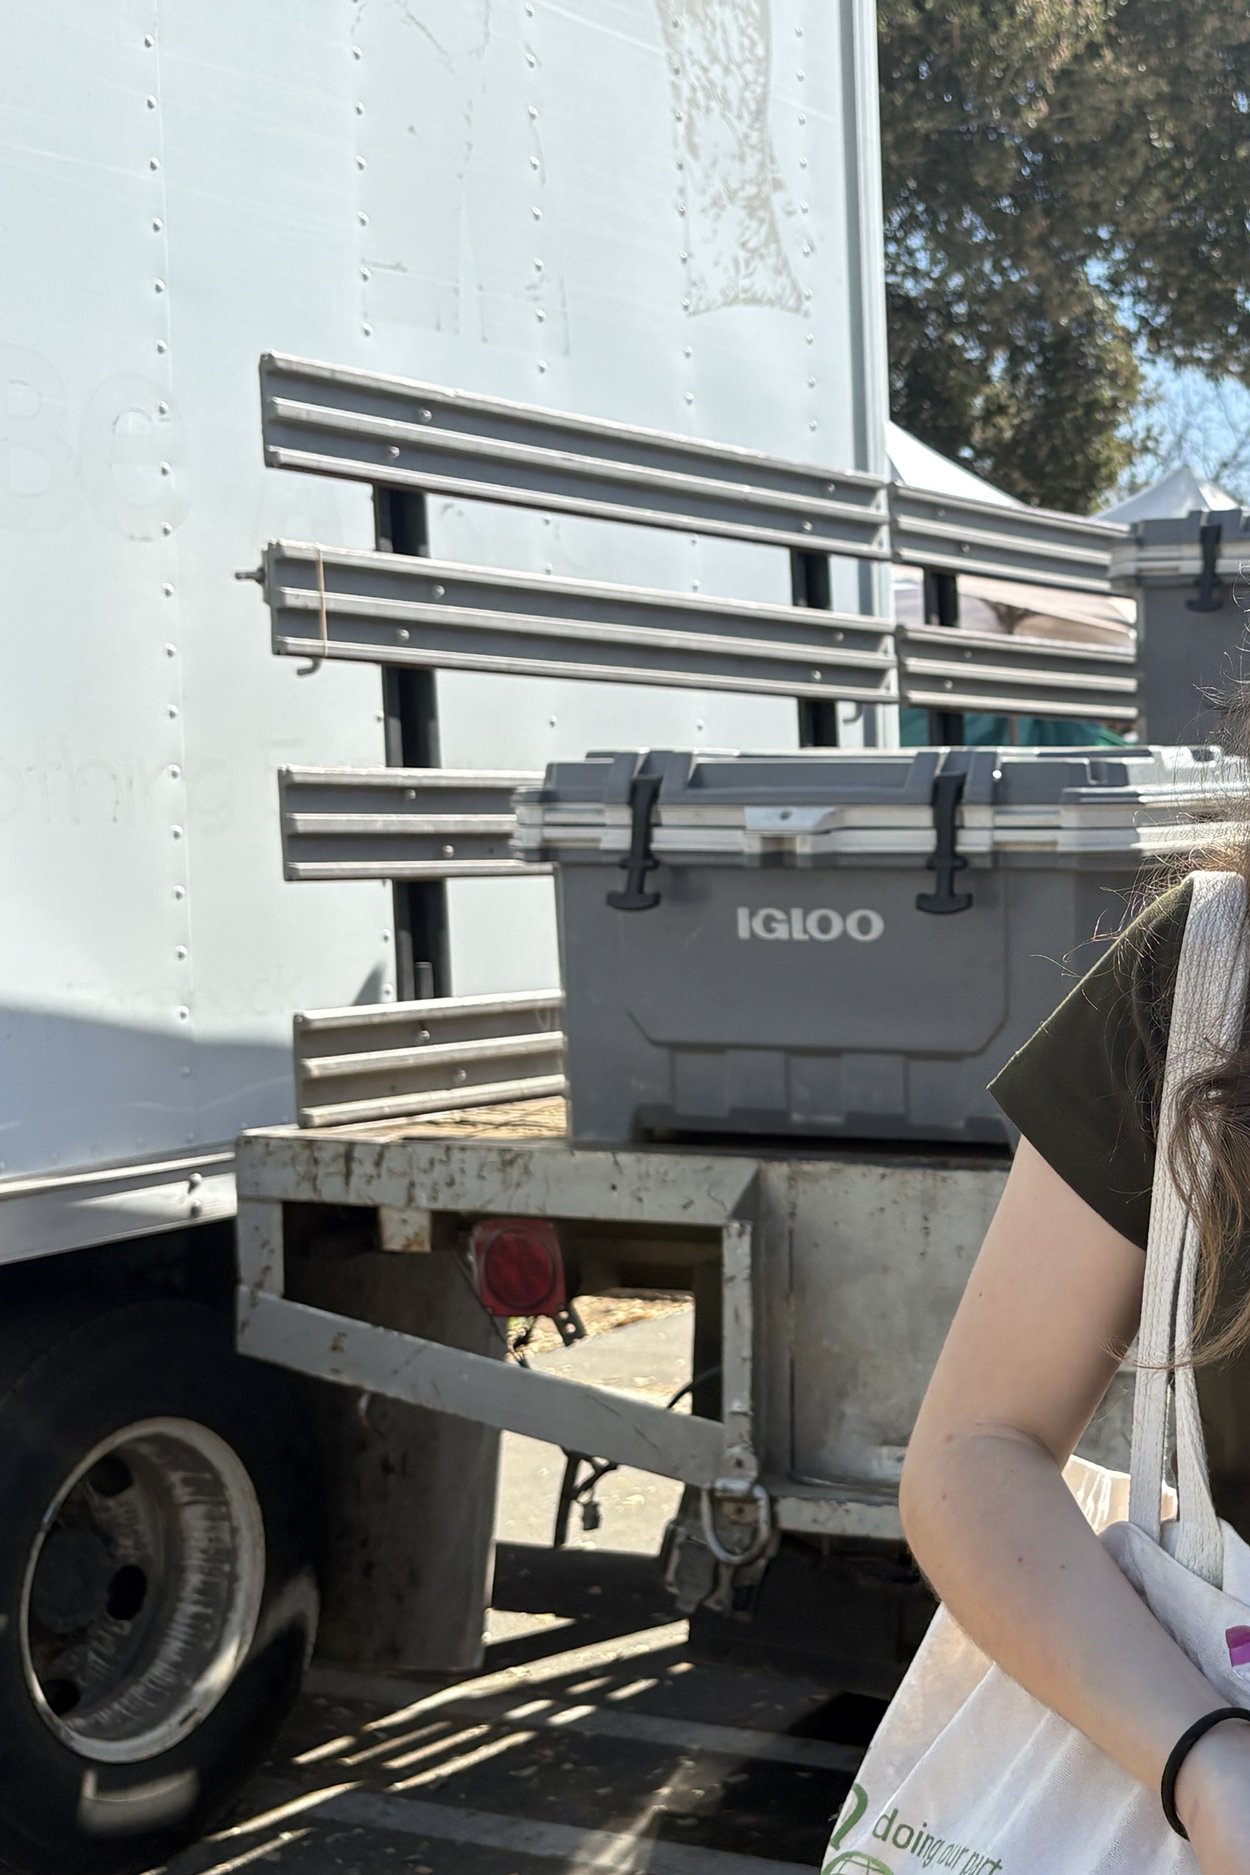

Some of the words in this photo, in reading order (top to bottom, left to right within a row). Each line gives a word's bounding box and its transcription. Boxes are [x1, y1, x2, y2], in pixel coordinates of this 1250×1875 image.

[737, 906, 885, 942] IGLOO
[872, 1808, 945, 1868] doing
[937, 1842, 970, 1870] our
